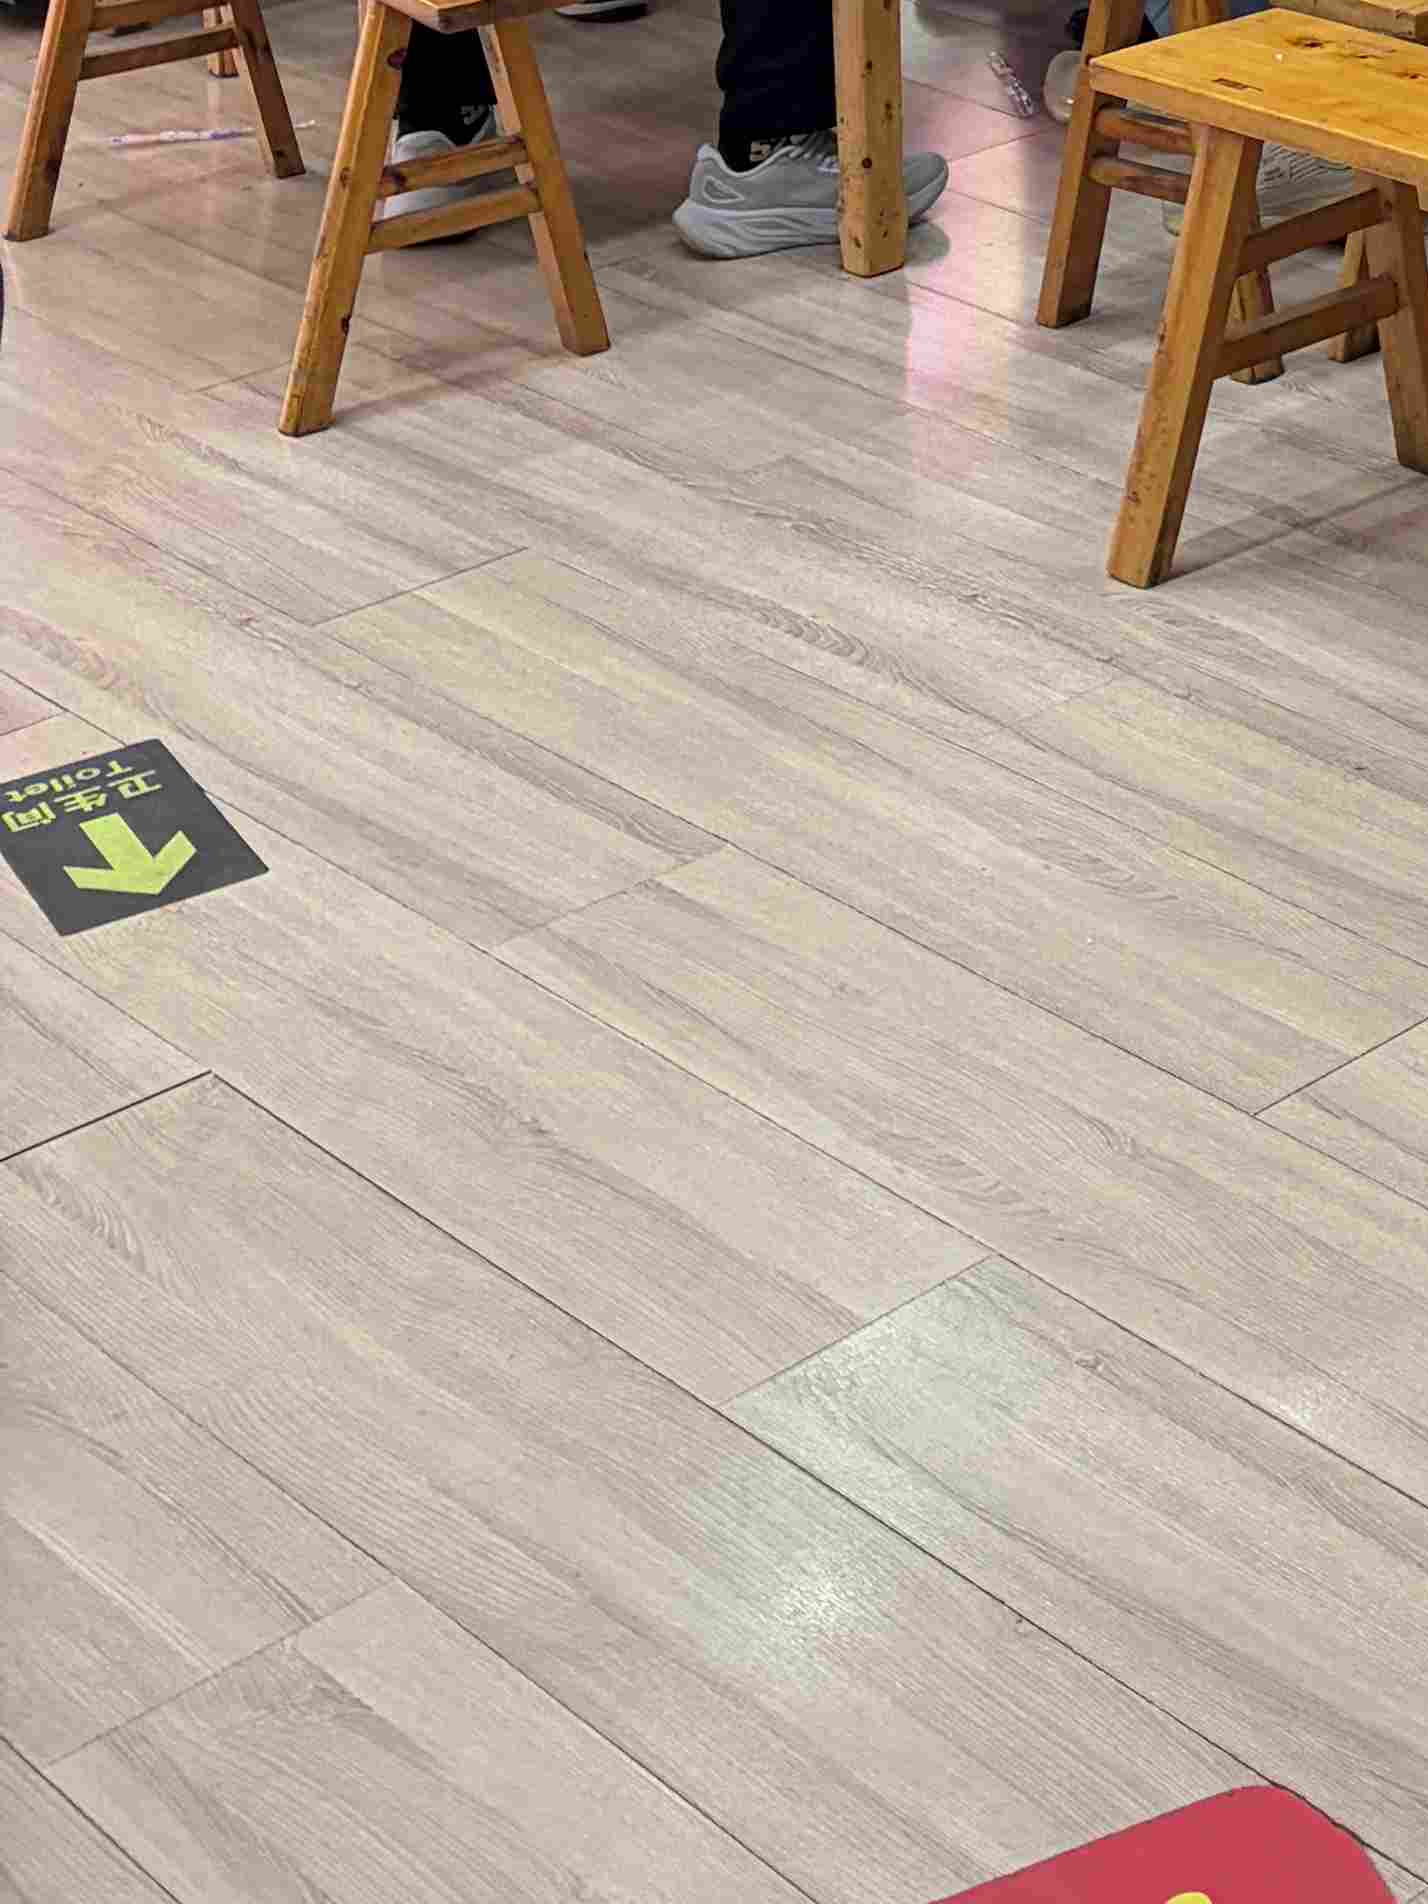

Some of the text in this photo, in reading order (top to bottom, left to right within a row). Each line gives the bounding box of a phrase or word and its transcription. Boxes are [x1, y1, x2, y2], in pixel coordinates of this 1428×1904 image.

[1, 769, 162, 832] 卫生间
[4, 760, 133, 802] Toilet
